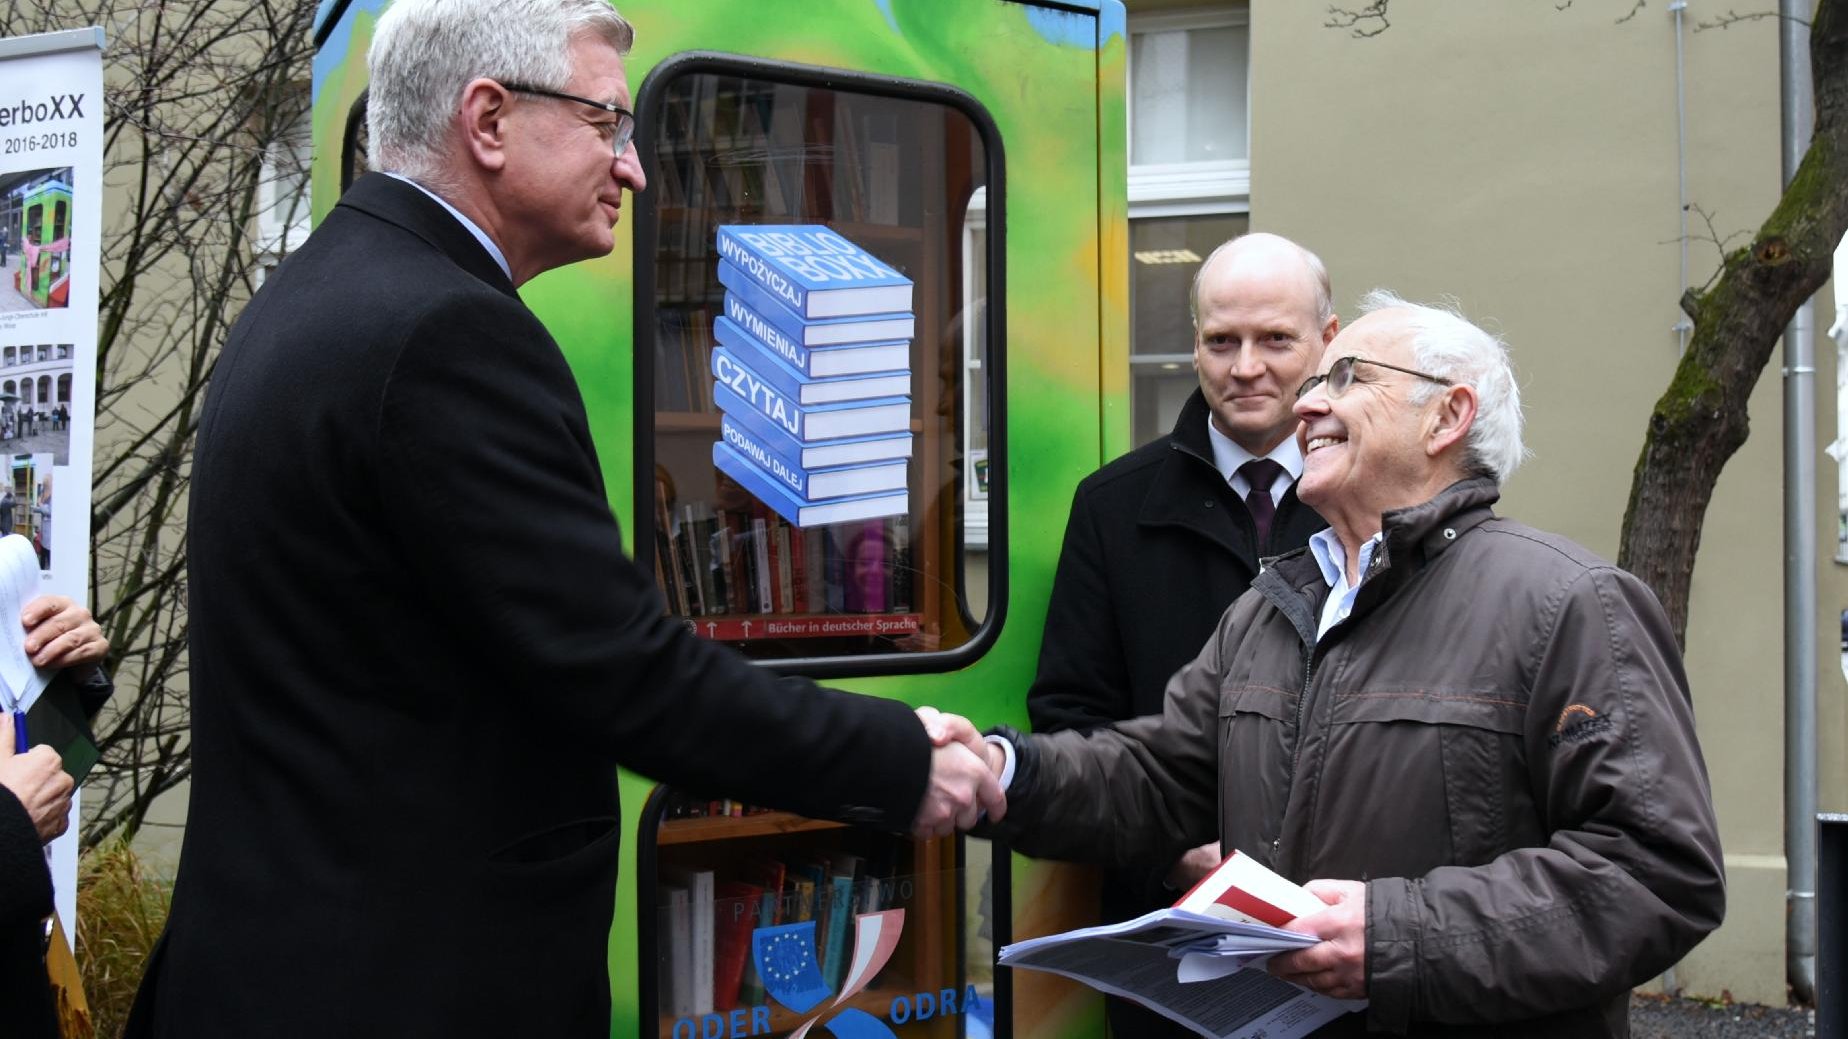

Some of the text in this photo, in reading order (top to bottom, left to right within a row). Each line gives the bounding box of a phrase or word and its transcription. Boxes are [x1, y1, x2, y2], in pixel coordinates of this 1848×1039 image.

[0, 93, 84, 127] erboXX
[5, 131, 77, 154] 2016-2018
[738, 232, 857, 257] BIBLIO
[721, 235, 802, 308] WYPOŻYCZAJ
[776, 254, 901, 282] BOXX
[730, 299, 805, 369] WYMIENIAJ
[716, 354, 799, 435] CZYTAJ
[724, 423, 803, 491] PODAWAJ DALEJ
[768, 616, 918, 634] Bücher in deutscher Sprache
[672, 984, 983, 1039] ODER ODRA
